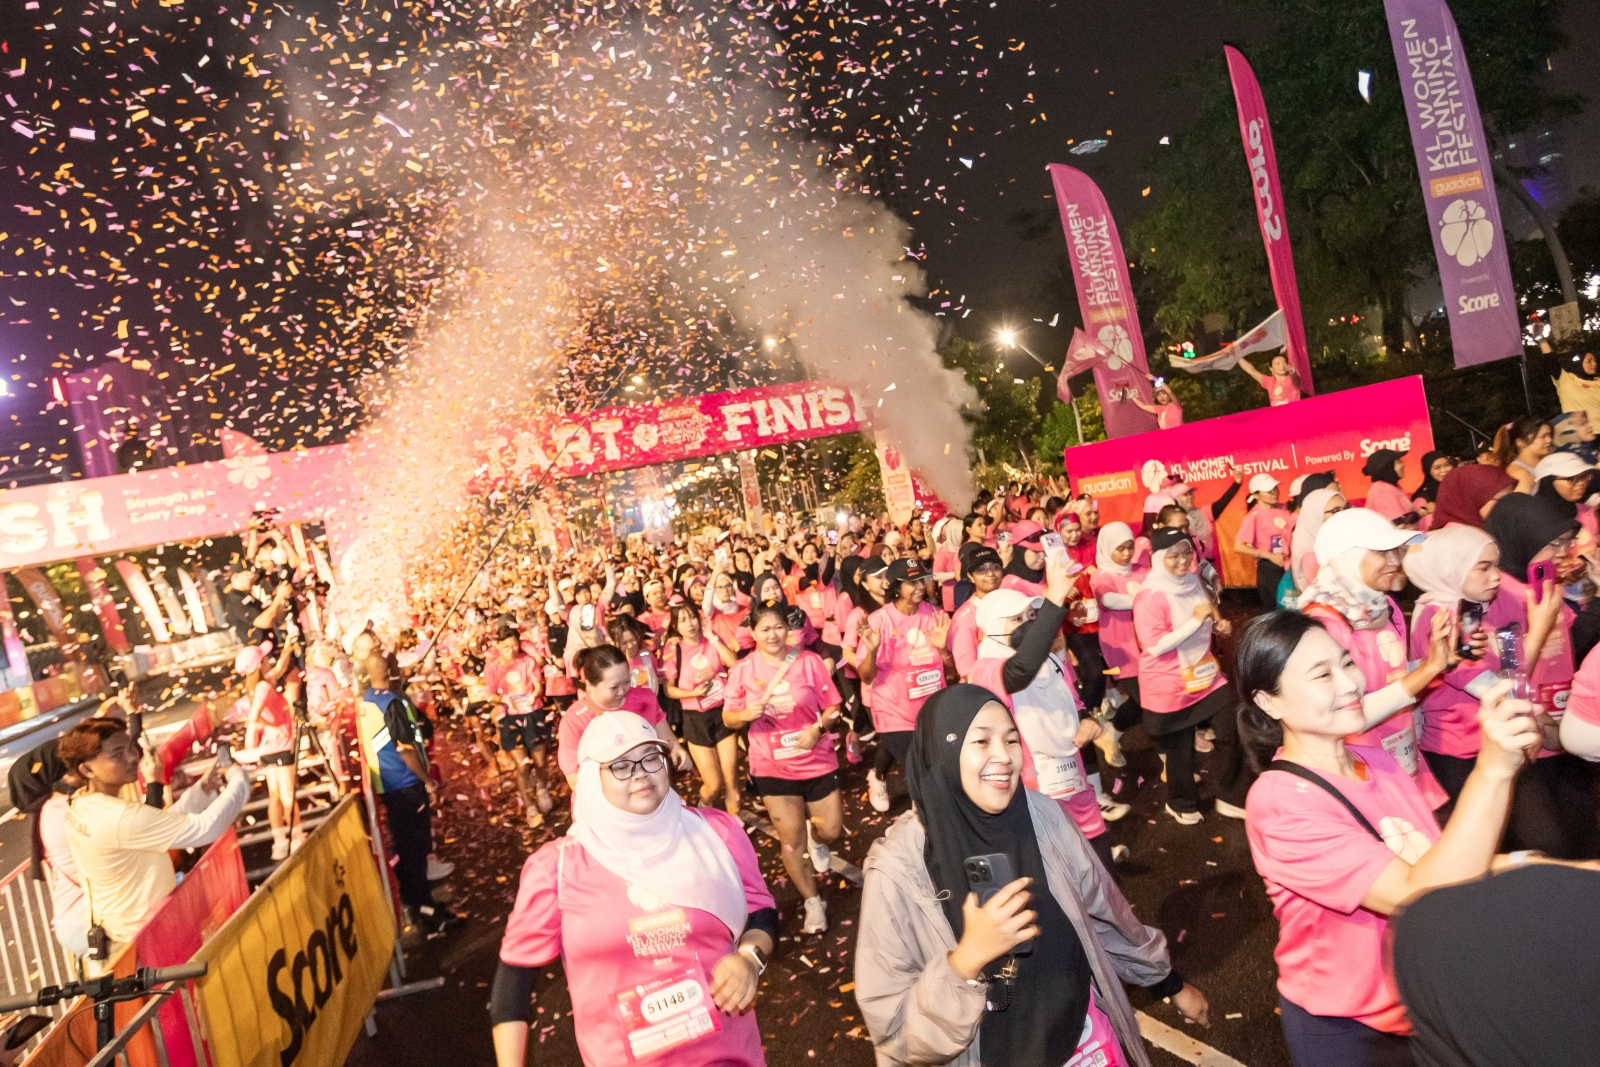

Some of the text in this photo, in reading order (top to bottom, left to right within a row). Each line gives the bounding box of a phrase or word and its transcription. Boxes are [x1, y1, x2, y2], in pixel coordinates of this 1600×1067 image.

[1401, 19, 1445, 171] KL WOMEN
[1422, 37, 1460, 168] RUNNING
[1439, 35, 1477, 165] FESTIVAL
[1066, 204, 1097, 306] KL WOMEN
[1083, 216, 1110, 305] RUNNING
[1095, 214, 1121, 302] FESTIVAL
[1458, 292, 1499, 315] Score
[1109, 387, 1139, 403] Sce
[474, 418, 624, 479] TART
[1305, 450, 1355, 466] Powered By
[1171, 456, 1234, 476] KL WOMEN
[1180, 467, 1227, 484] UNNING
[1083, 476, 1132, 496] guardian
[130, 509, 170, 524] Every
[626, 921, 691, 944] KL WOMEN
[634, 913, 680, 931] guardian
[632, 931, 687, 949] RUNNING
[634, 938, 687, 958] FESTIVAL
[267, 893, 358, 1067] Score
[647, 991, 685, 1014] 51148
